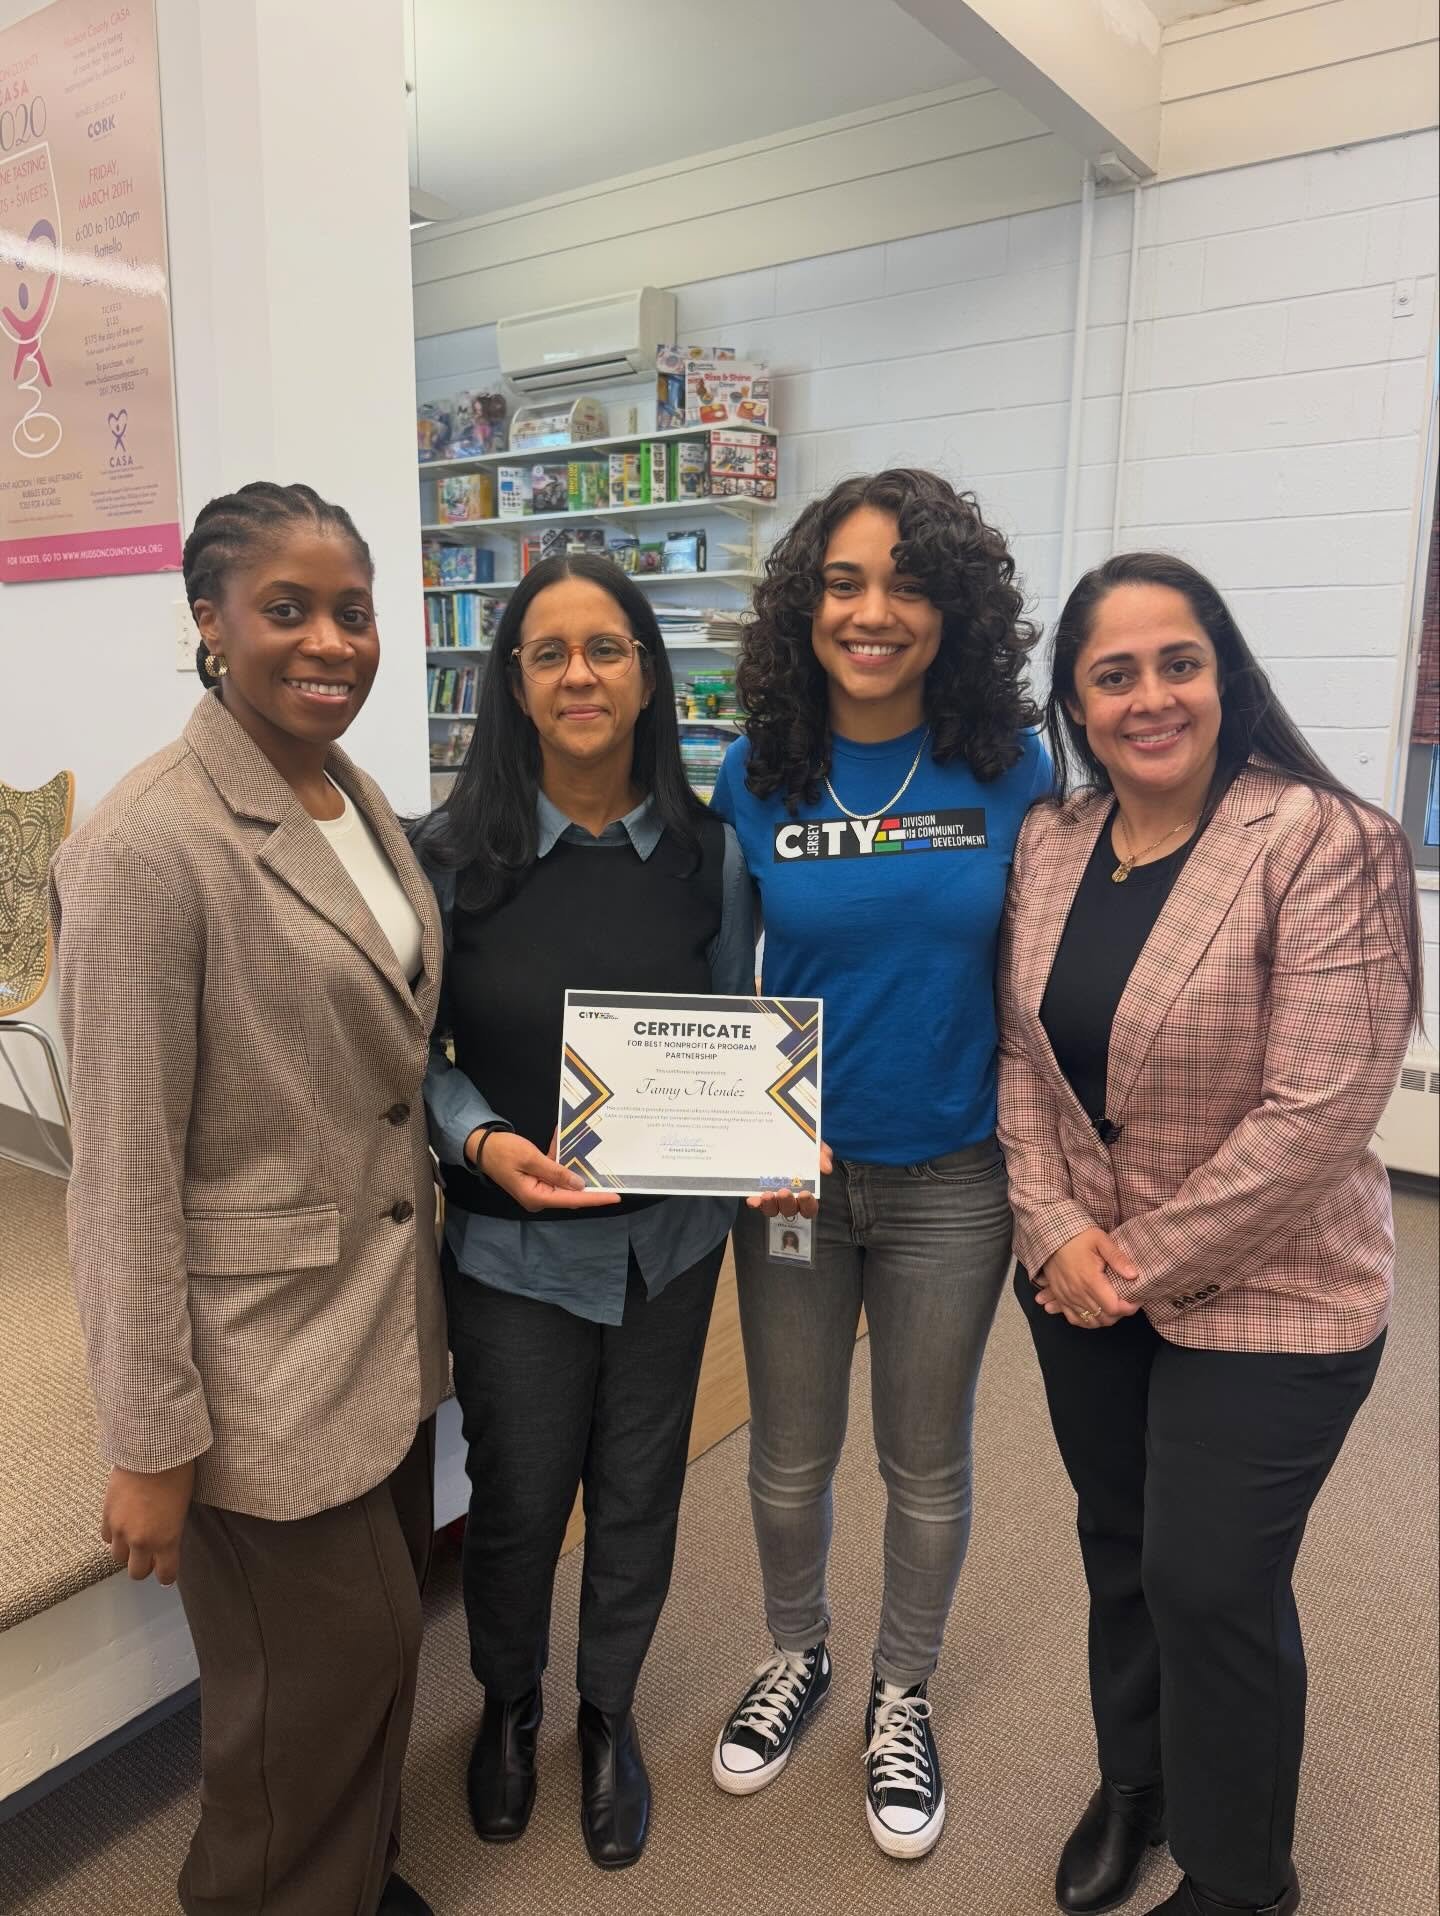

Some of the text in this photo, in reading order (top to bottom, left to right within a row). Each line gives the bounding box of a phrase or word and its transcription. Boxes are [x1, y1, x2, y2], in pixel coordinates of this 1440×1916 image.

[87, 113, 116, 138] CORK
[109, 455, 134, 468] CASA
[902, 814, 936, 828] DIVISION
[917, 824, 964, 838] COMMUNITY
[806, 824, 820, 857] JERSEY
[932, 834, 986, 848] DEVELOPMENT
[633, 1021, 752, 1039] CERTIFICATE
[644, 1040, 663, 1048] BEST
[664, 1041, 708, 1049] NONPROFIT
[710, 1042, 716, 1050] &
[717, 1043, 757, 1051] PROGRAM
[665, 1051, 718, 1060] PARTNERSHIP
[684, 1078, 745, 1098] Mendez
